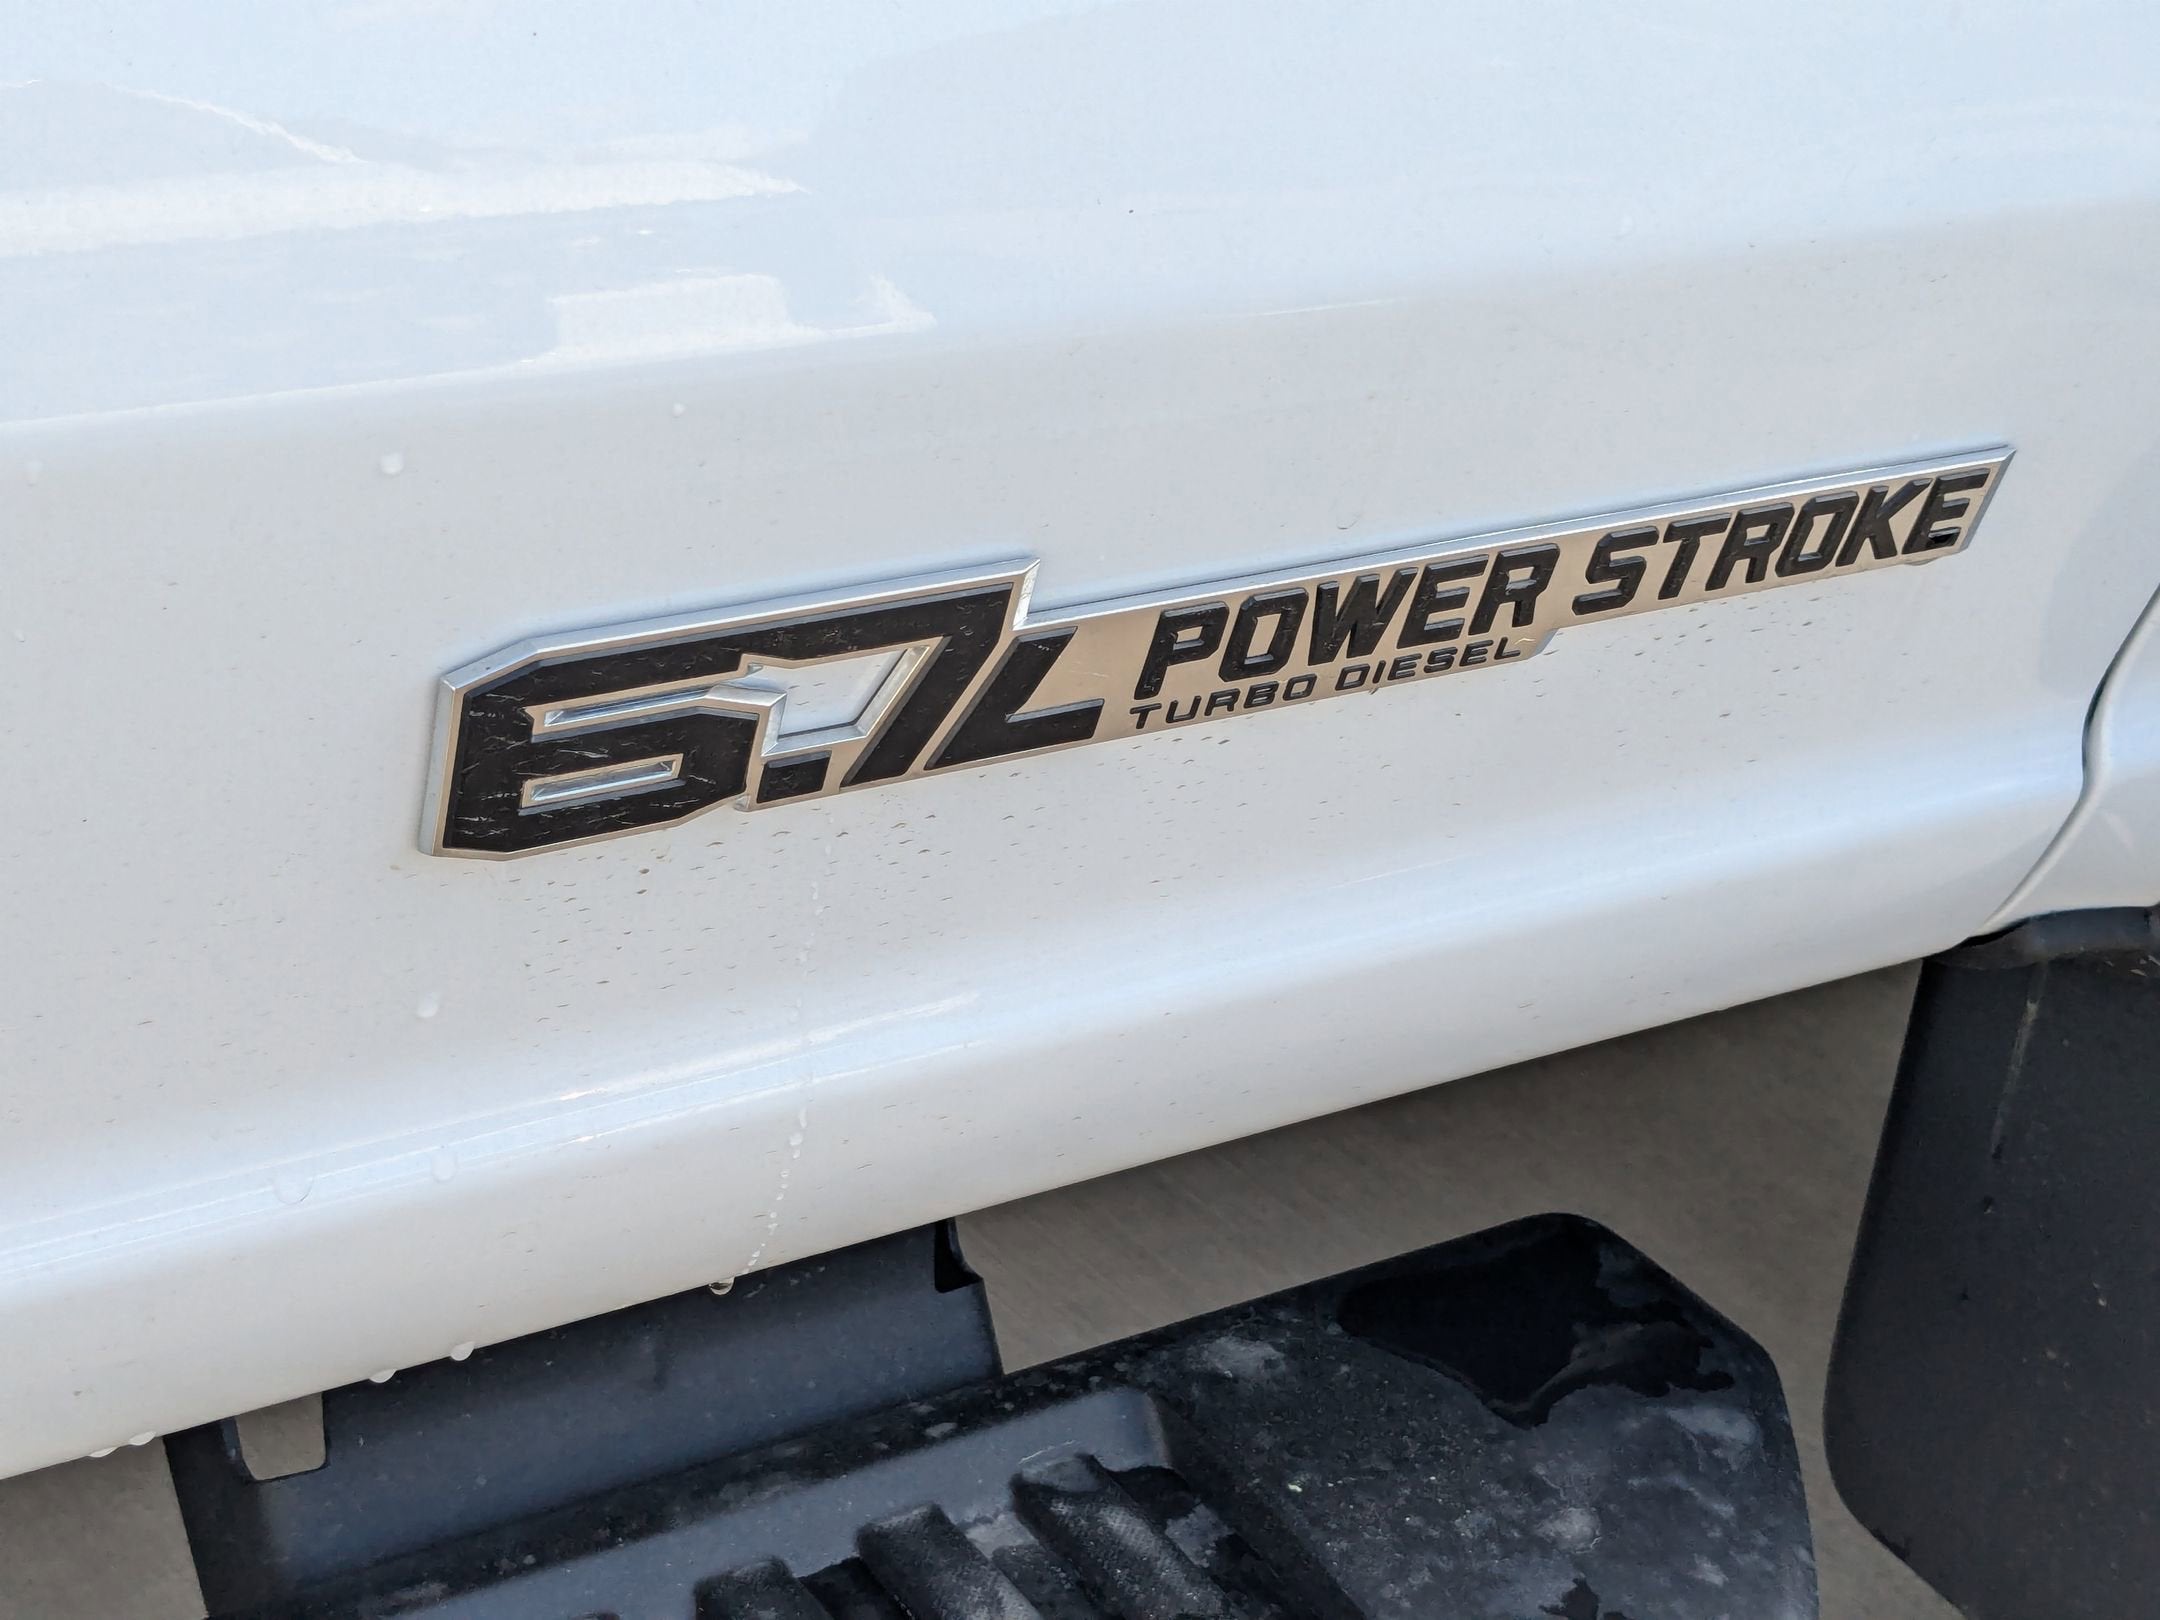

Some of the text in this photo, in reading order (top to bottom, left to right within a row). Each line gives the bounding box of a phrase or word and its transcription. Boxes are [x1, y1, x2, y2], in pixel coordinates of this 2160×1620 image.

[443, 468, 1990, 849] 6.7L POWER STROKE
[1129, 637, 1522, 730] TURBO DIESEL
